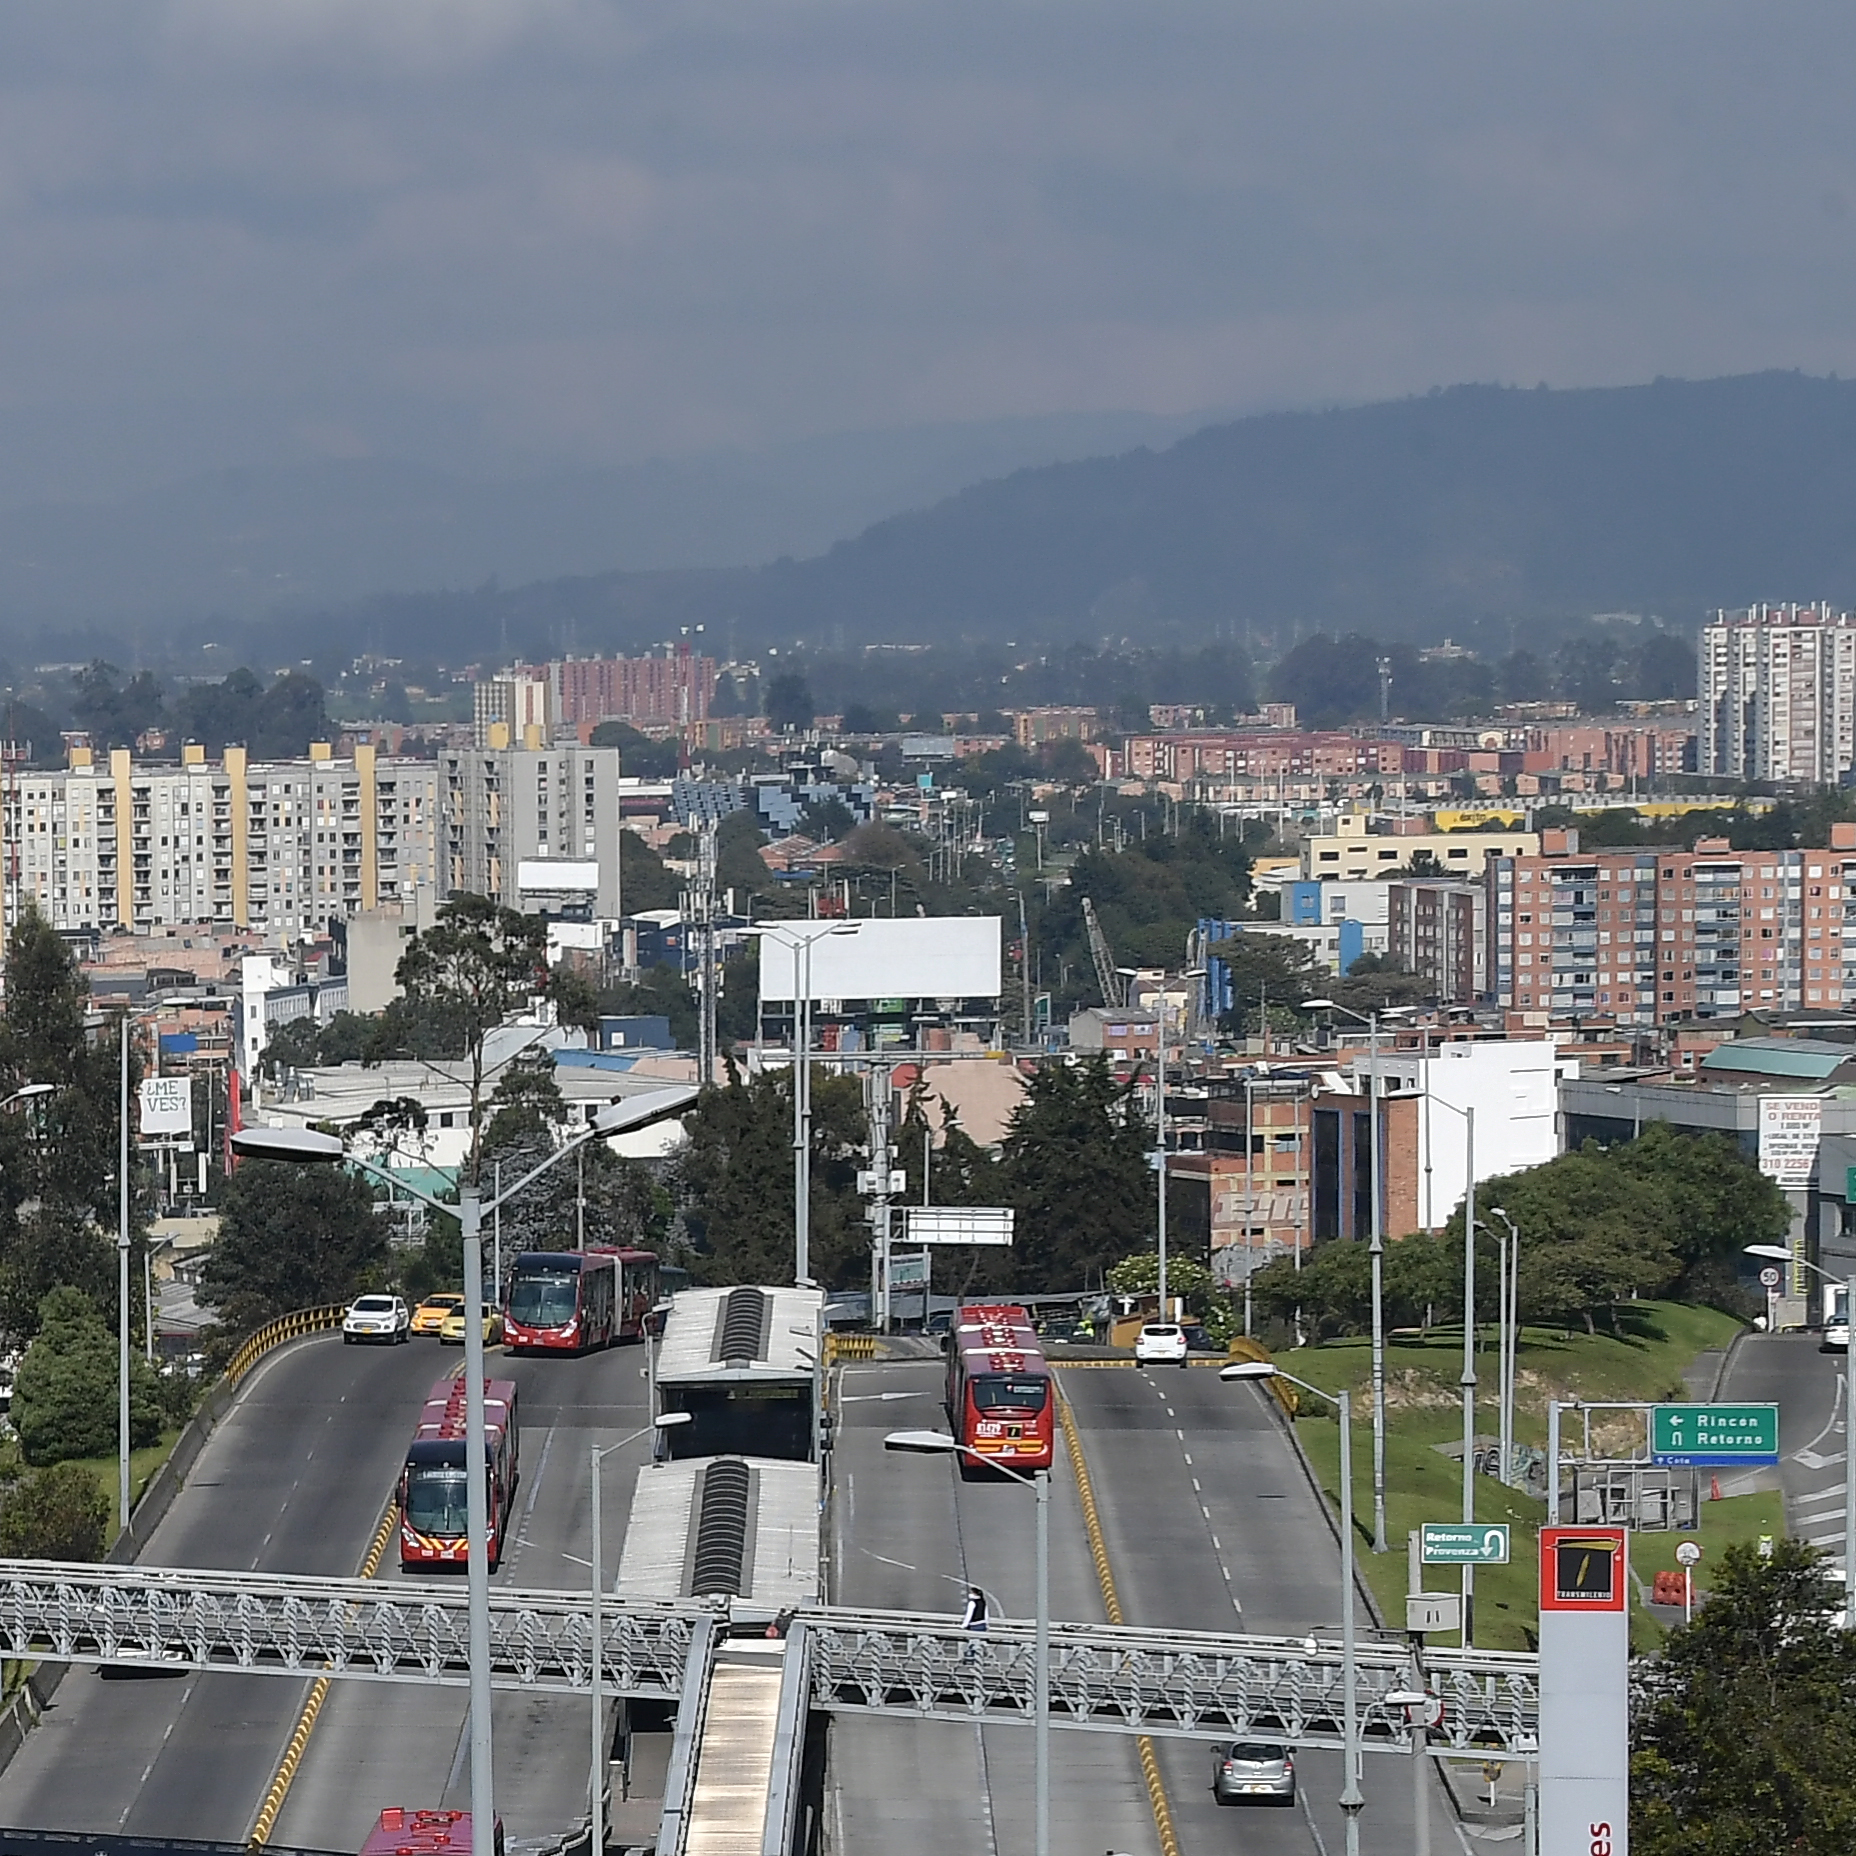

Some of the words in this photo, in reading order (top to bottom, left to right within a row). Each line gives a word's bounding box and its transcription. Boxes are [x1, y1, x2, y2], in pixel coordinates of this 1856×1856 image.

[146, 1080, 179, 1096] ¿ME
[146, 1096, 187, 1113] VES?
[1762, 1271, 1777, 1283] 50
[1696, 1433, 1764, 1446] Retorno
[1425, 1532, 1473, 1544] Retorno
